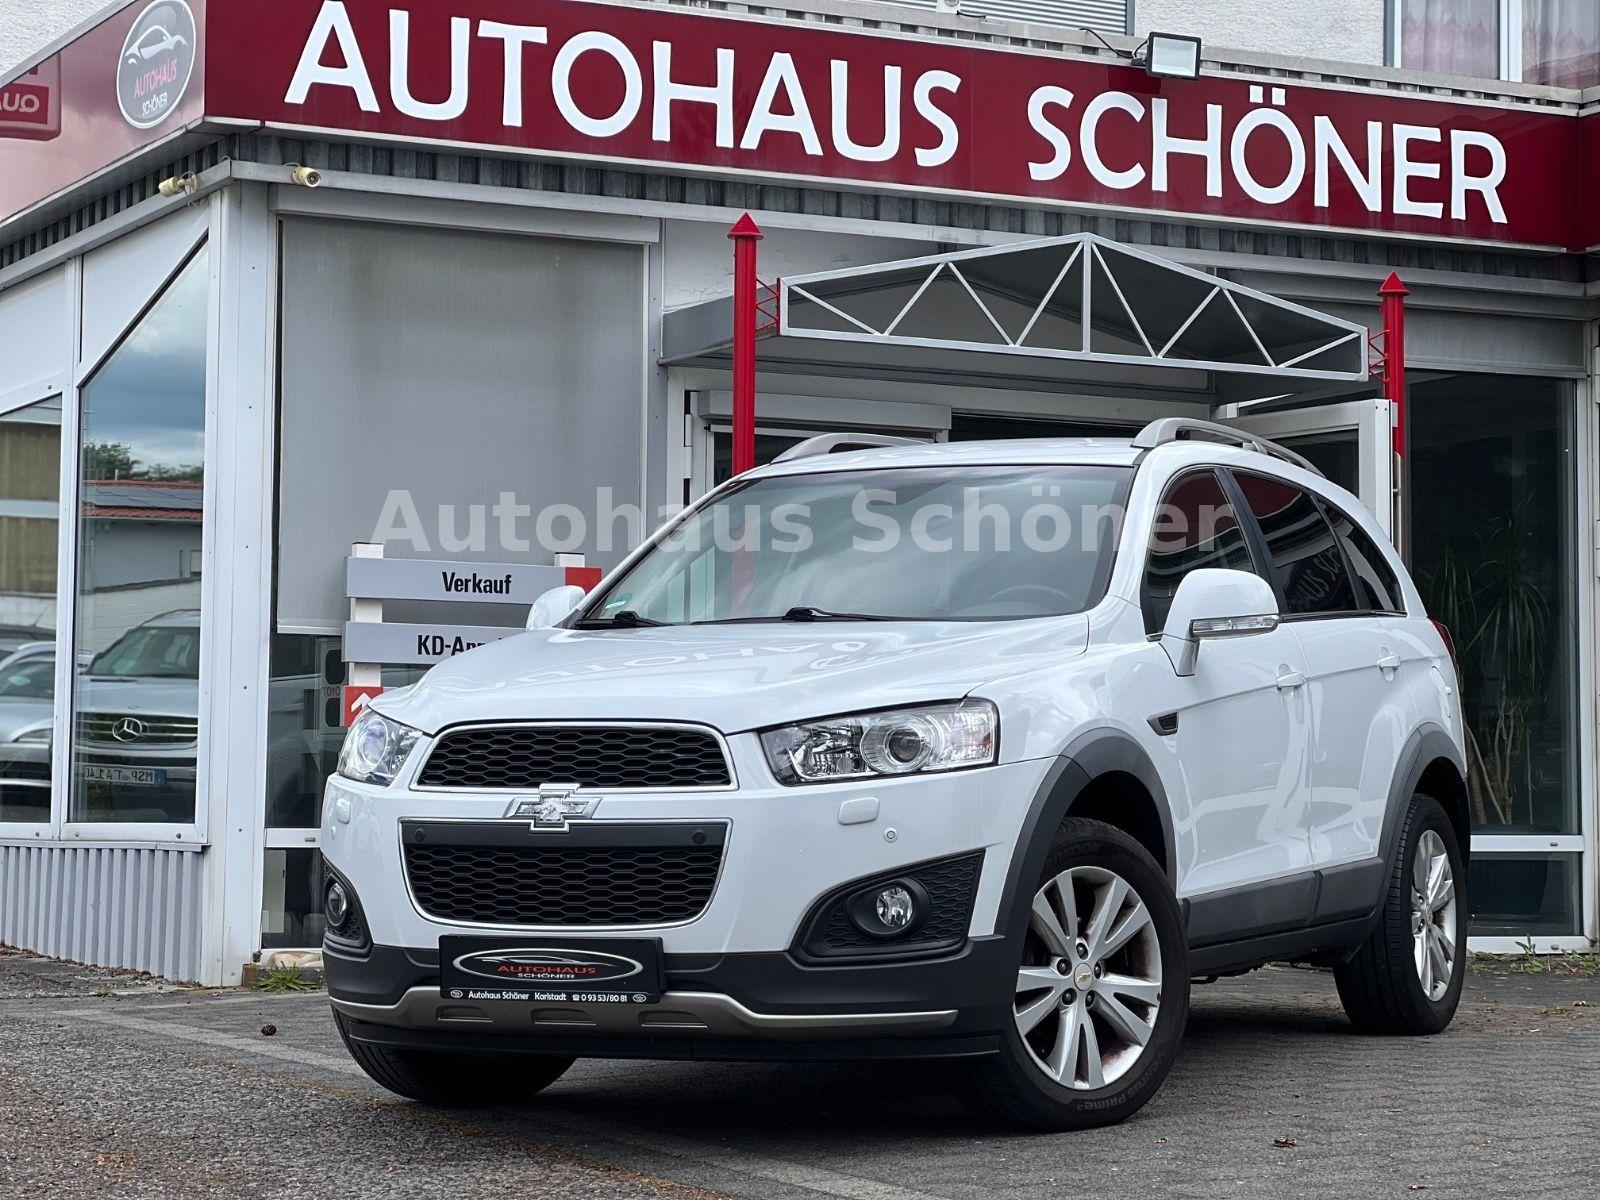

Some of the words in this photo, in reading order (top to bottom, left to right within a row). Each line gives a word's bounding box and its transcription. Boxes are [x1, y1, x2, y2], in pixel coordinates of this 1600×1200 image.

[133, 59, 178, 98] AUTOHAUS
[142, 92, 168, 116] SCHÖNER
[284, 0, 962, 168] AUTOHAUS
[1026, 85, 1508, 225] SCHÖNER
[442, 571, 512, 594] Verkauf
[497, 965, 597, 974] AUTOHAUS
[468, 990, 501, 999] Autohaus
[502, 990, 530, 1000] Schöner
[534, 992, 567, 1001] Karlstadt
